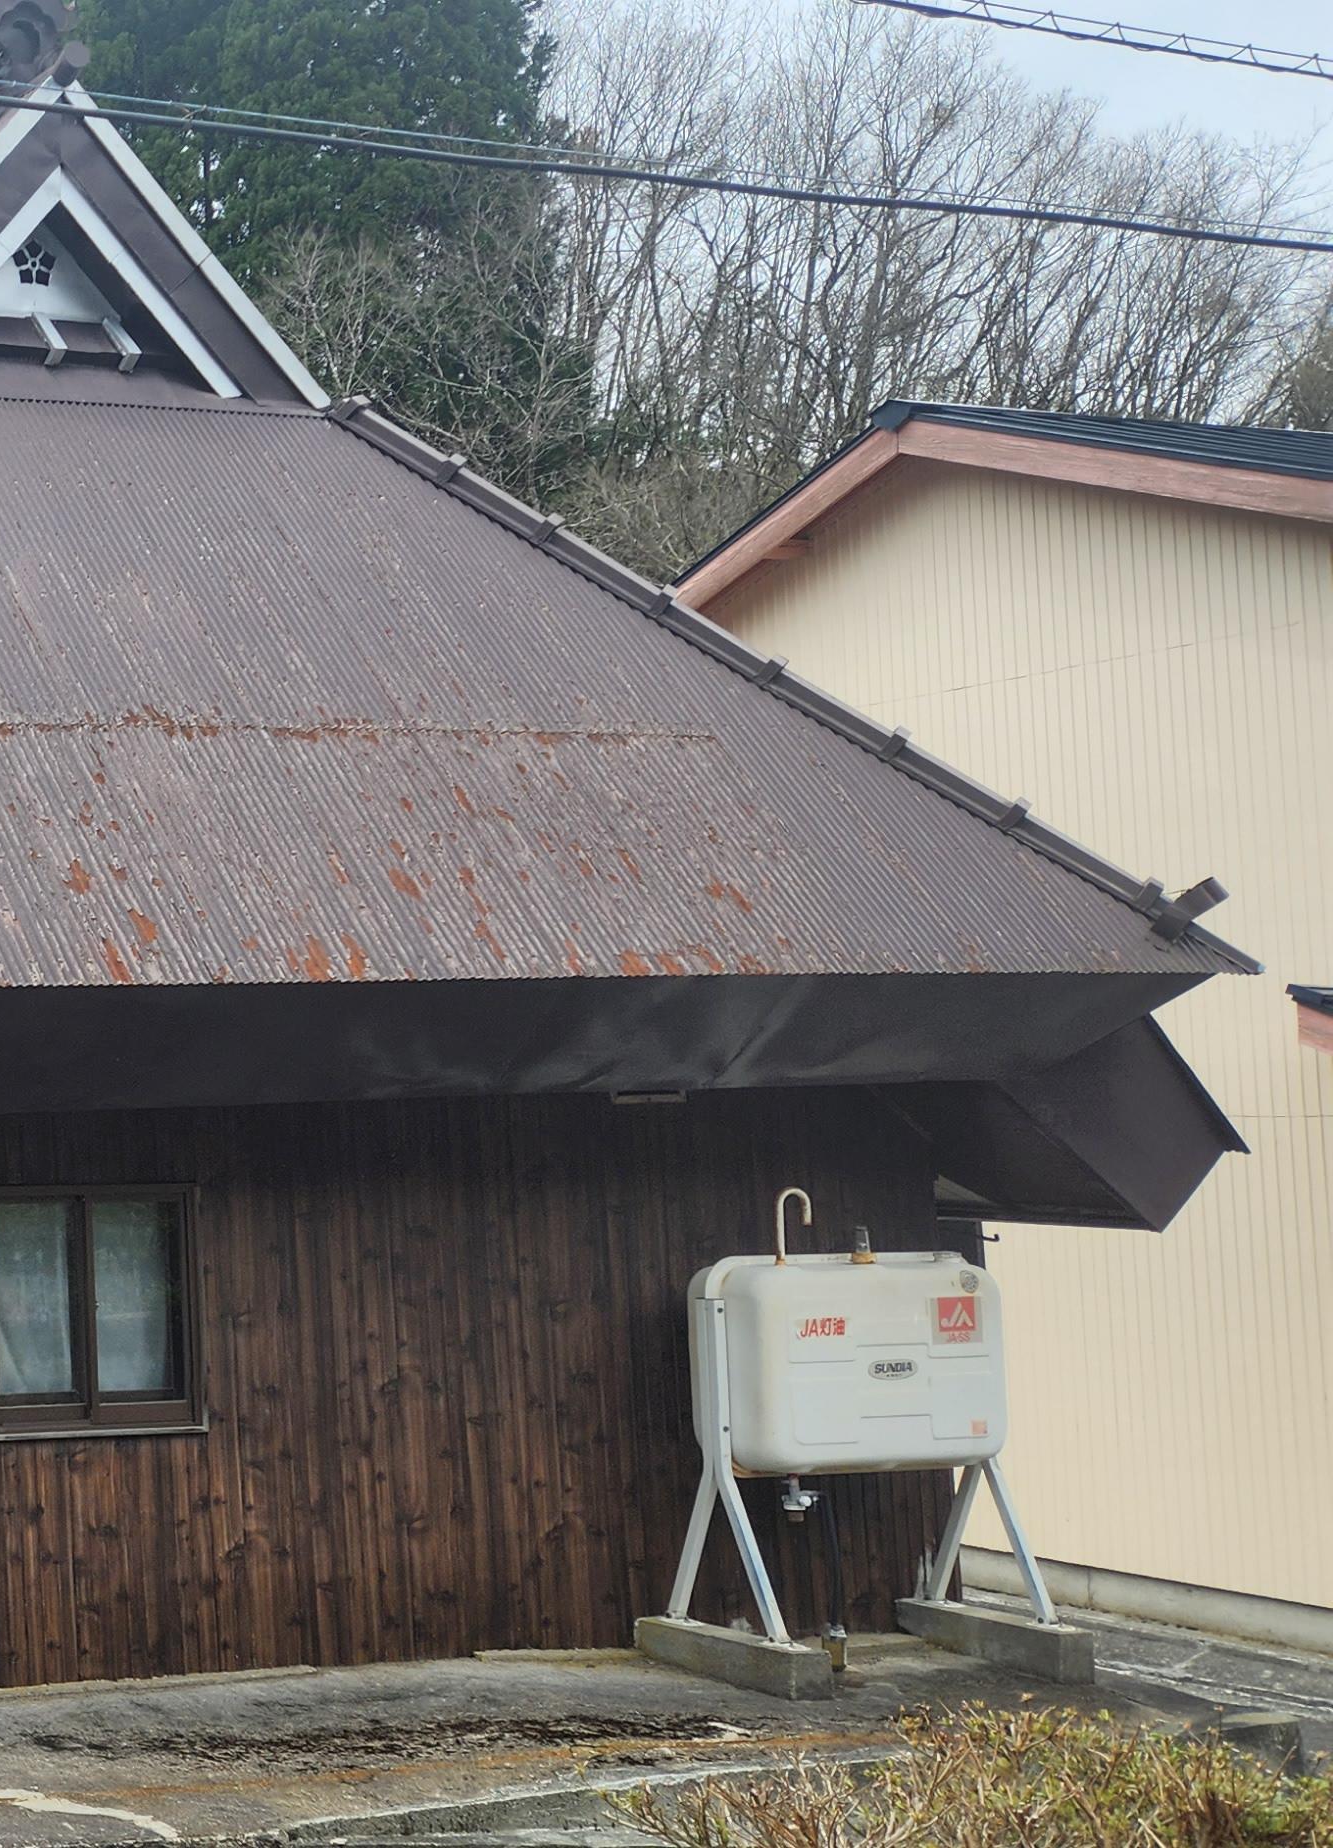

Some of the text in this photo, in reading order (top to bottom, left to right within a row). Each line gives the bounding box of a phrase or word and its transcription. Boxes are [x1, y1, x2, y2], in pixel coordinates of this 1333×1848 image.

[940, 1301, 974, 1328] JA
[800, 1317, 845, 1338] JA灯油
[874, 1362, 913, 1374] SUNDIA
